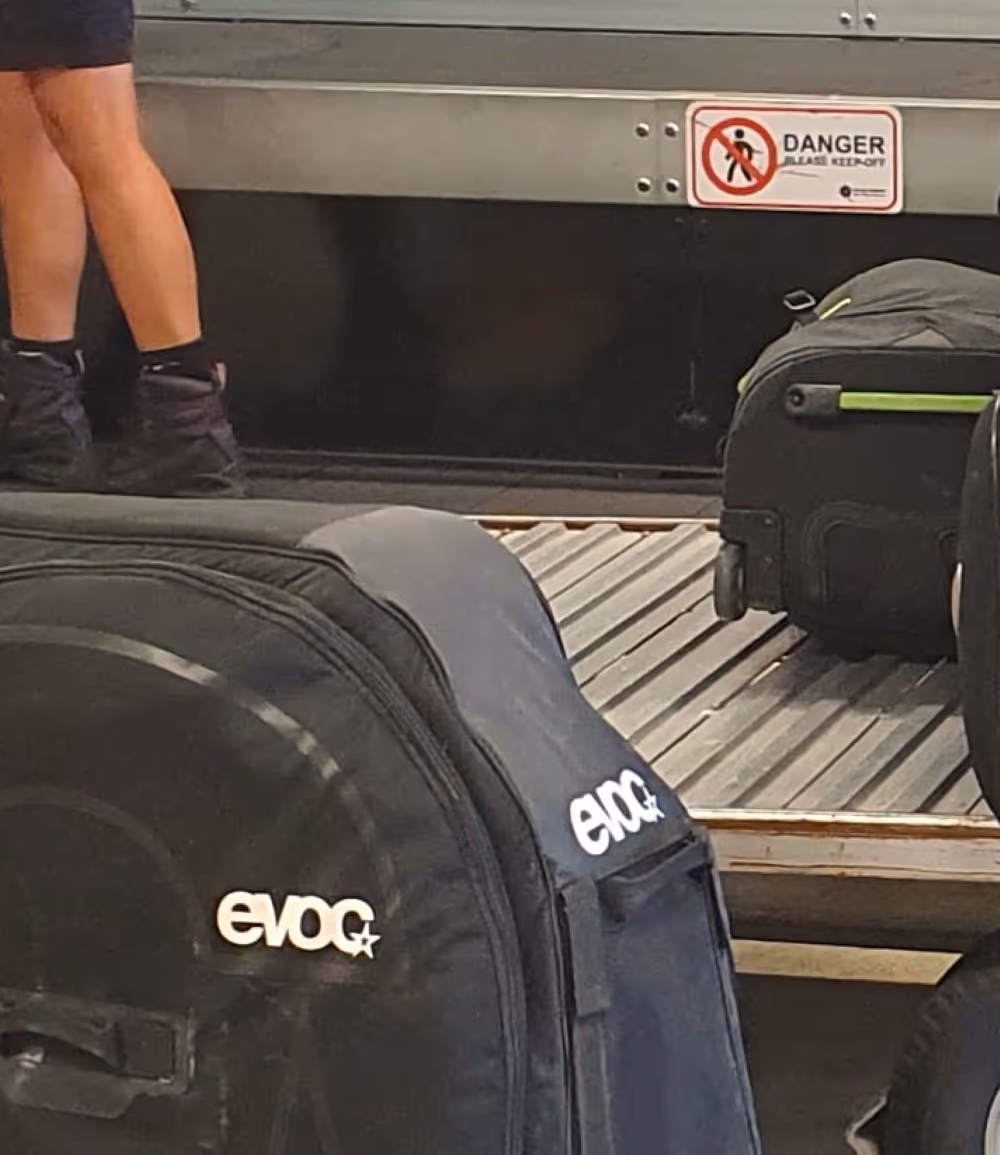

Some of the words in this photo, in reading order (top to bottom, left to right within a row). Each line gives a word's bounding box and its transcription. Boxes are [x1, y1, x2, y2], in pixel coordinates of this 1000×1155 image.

[784, 134, 885, 154] DANGER
[784, 156, 828, 166] PLEASE
[570, 768, 666, 855] evoc
[216, 890, 382, 958] evoc
